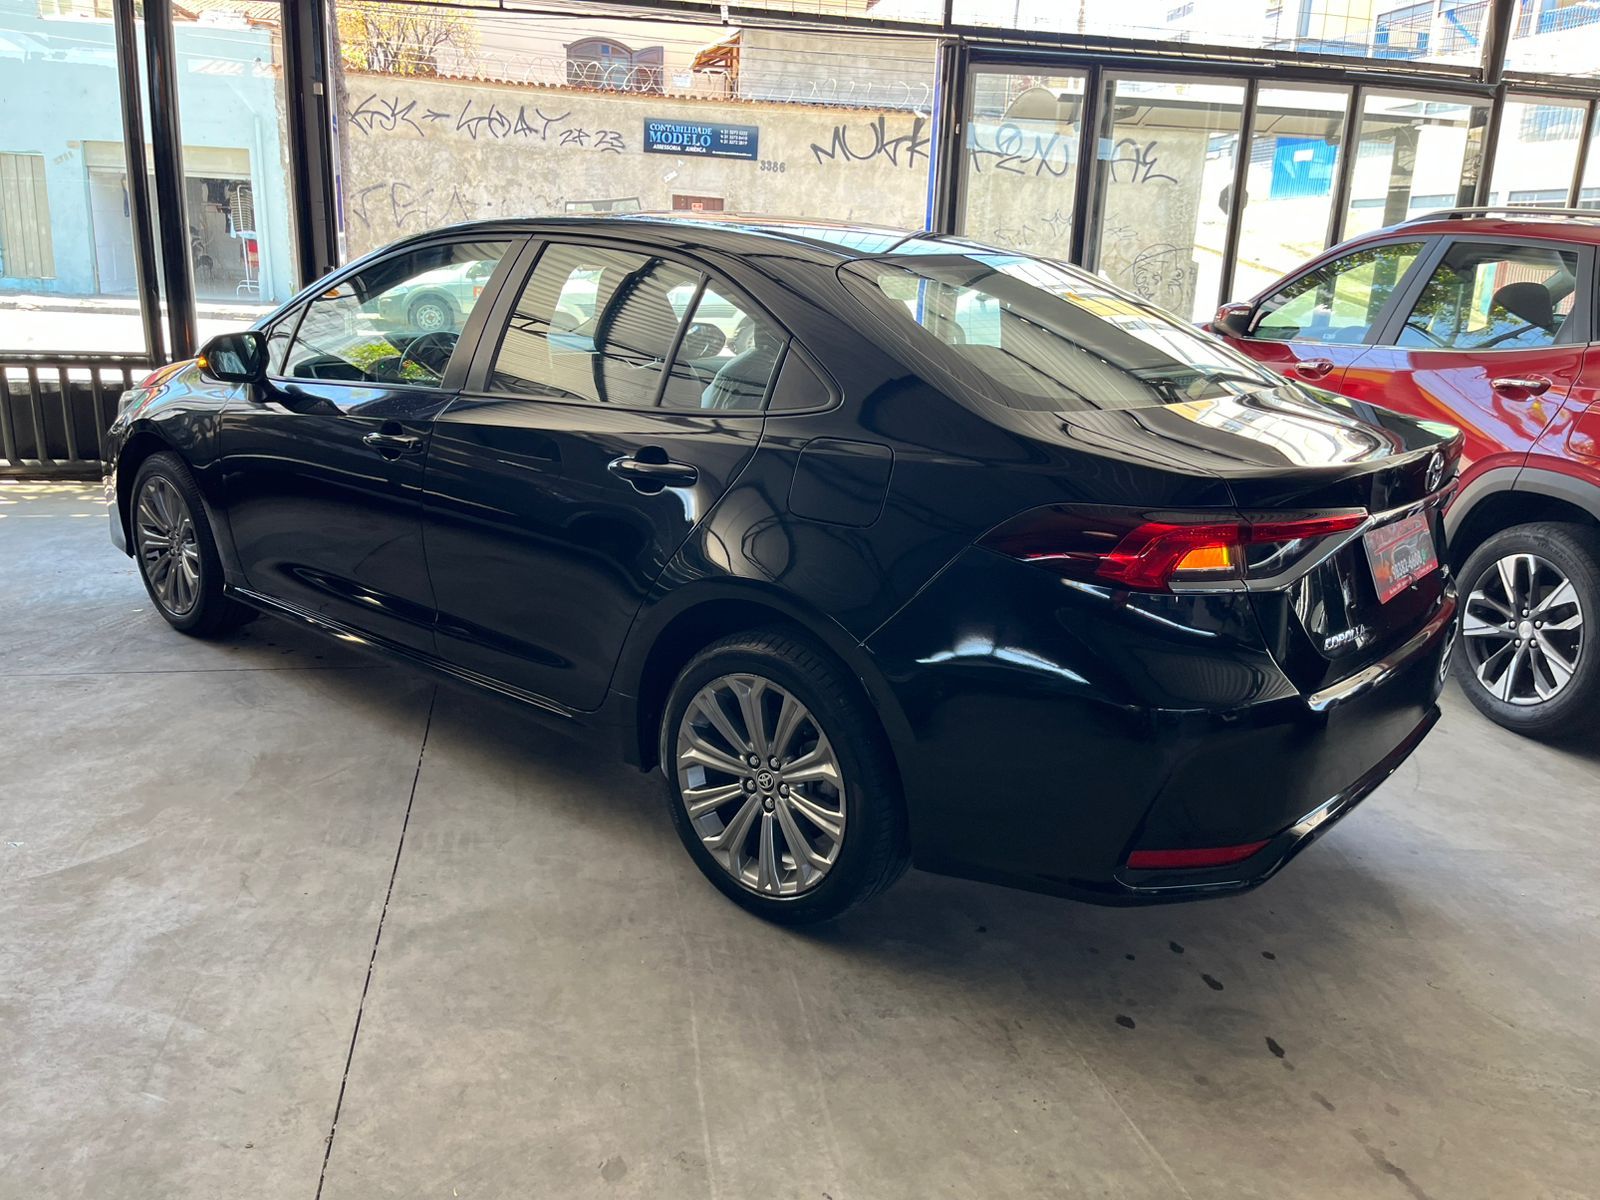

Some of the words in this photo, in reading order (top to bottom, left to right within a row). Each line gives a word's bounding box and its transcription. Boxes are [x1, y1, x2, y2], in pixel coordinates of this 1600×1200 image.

[650, 123, 712, 135] CONTABILIDADE
[650, 131, 711, 147] MODELO
[760, 160, 786, 173] 3386
